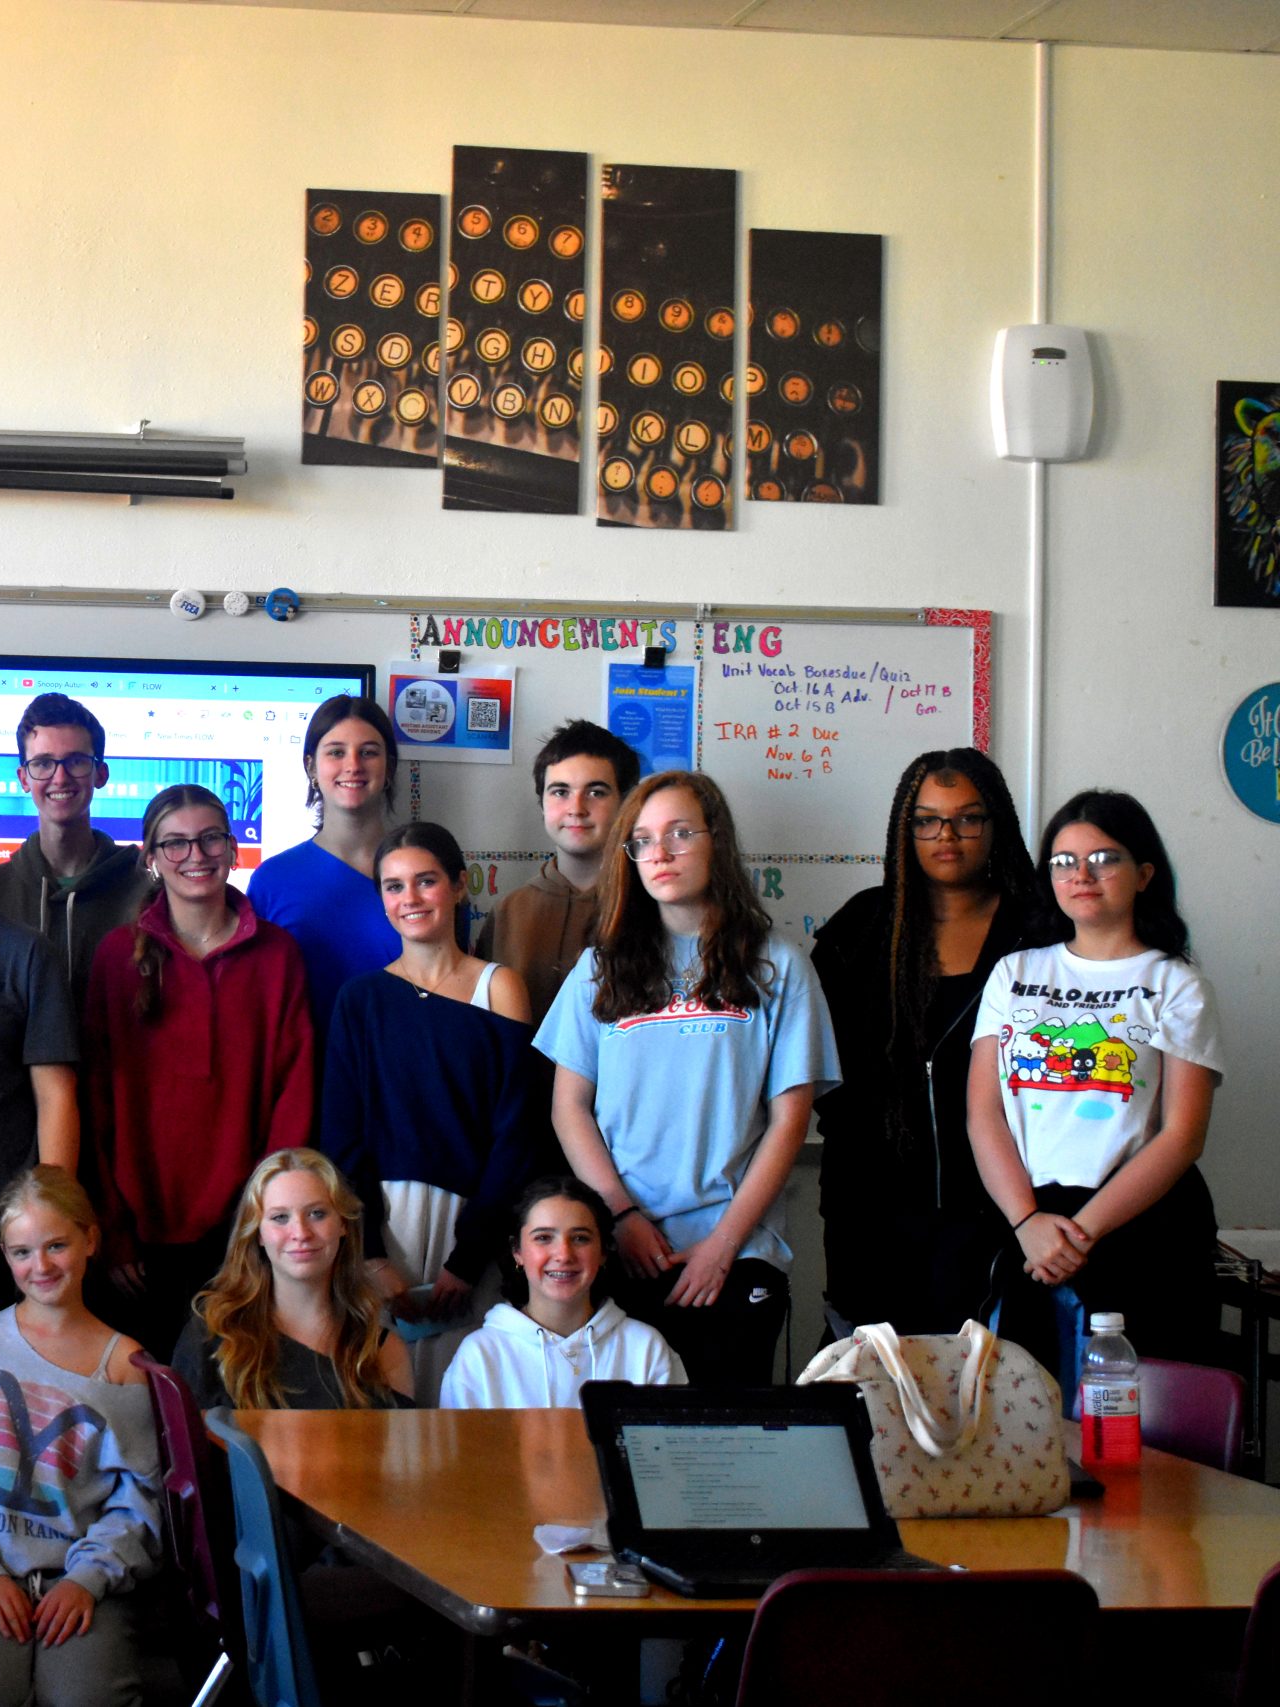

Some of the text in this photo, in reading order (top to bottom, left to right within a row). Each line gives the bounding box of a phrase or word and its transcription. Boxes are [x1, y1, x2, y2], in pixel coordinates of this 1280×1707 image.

[471, 212, 573, 244] 5 6 7
[333, 273, 350, 293] Z
[379, 282, 396, 303] E
[482, 279, 497, 298] T
[529, 288, 544, 309] Y
[340, 333, 356, 353] S
[387, 341, 404, 360] D
[484, 337, 546, 366] G H
[314, 380, 332, 401] W
[362, 389, 377, 409] X
[458, 383, 564, 422] V B N
[640, 419, 655, 439] K
[685, 427, 699, 448] L
[747, 427, 763, 449] M
[420, 614, 678, 652] ANNOUNCEMENTS
[712, 621, 783, 658] ENG
[722, 662, 753, 679] Unit
[758, 663, 796, 678] Vocab
[37, 680, 61, 690] Snoopy
[142, 682, 162, 691] FLOW
[637, 688, 678, 697] Student
[823, 682, 835, 697] A
[825, 701, 836, 714] B
[713, 721, 758, 741] IRA
[787, 723, 800, 738] 2
[812, 726, 840, 741] Due
[801, 748, 813, 763] 6
[802, 768, 813, 779] 7
[1010, 980, 1082, 1002] HELLO
[1046, 999, 1118, 1011] AND FRIENDS
[679, 1022, 727, 1036] CLUB
